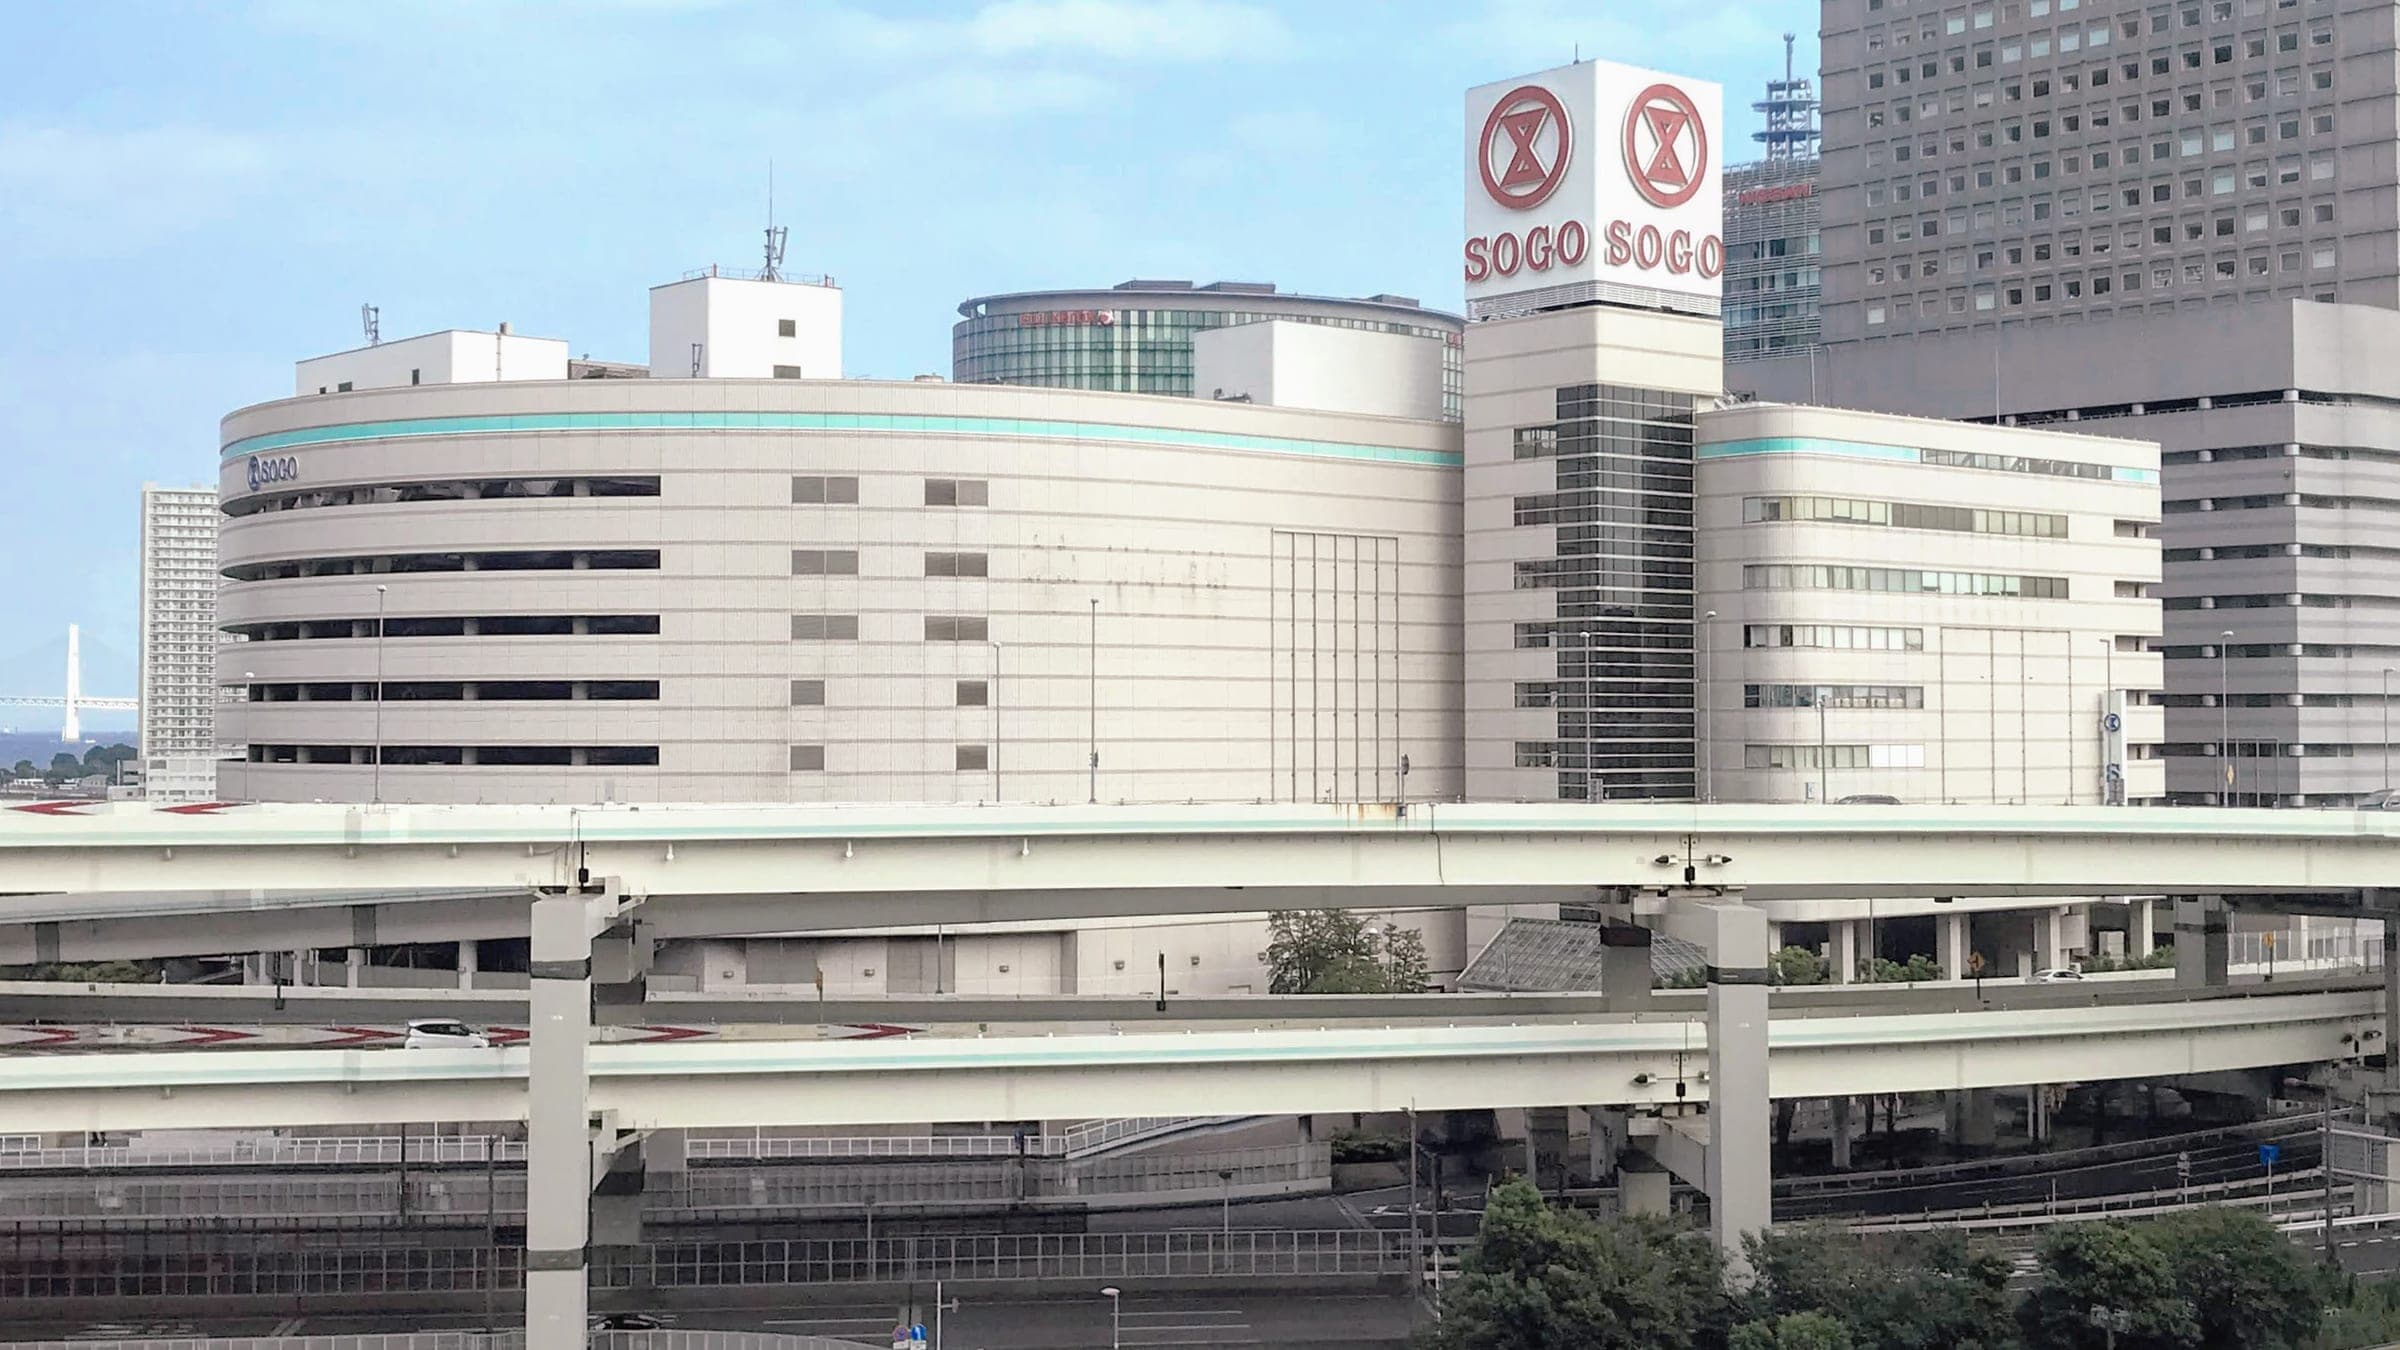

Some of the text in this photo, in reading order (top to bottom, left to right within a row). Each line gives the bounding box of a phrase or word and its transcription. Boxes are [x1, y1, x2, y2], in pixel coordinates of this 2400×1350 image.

[1465, 219, 1586, 283] SOGO
[1605, 219, 1725, 279] SOGO
[260, 456, 298, 483] SOGO
